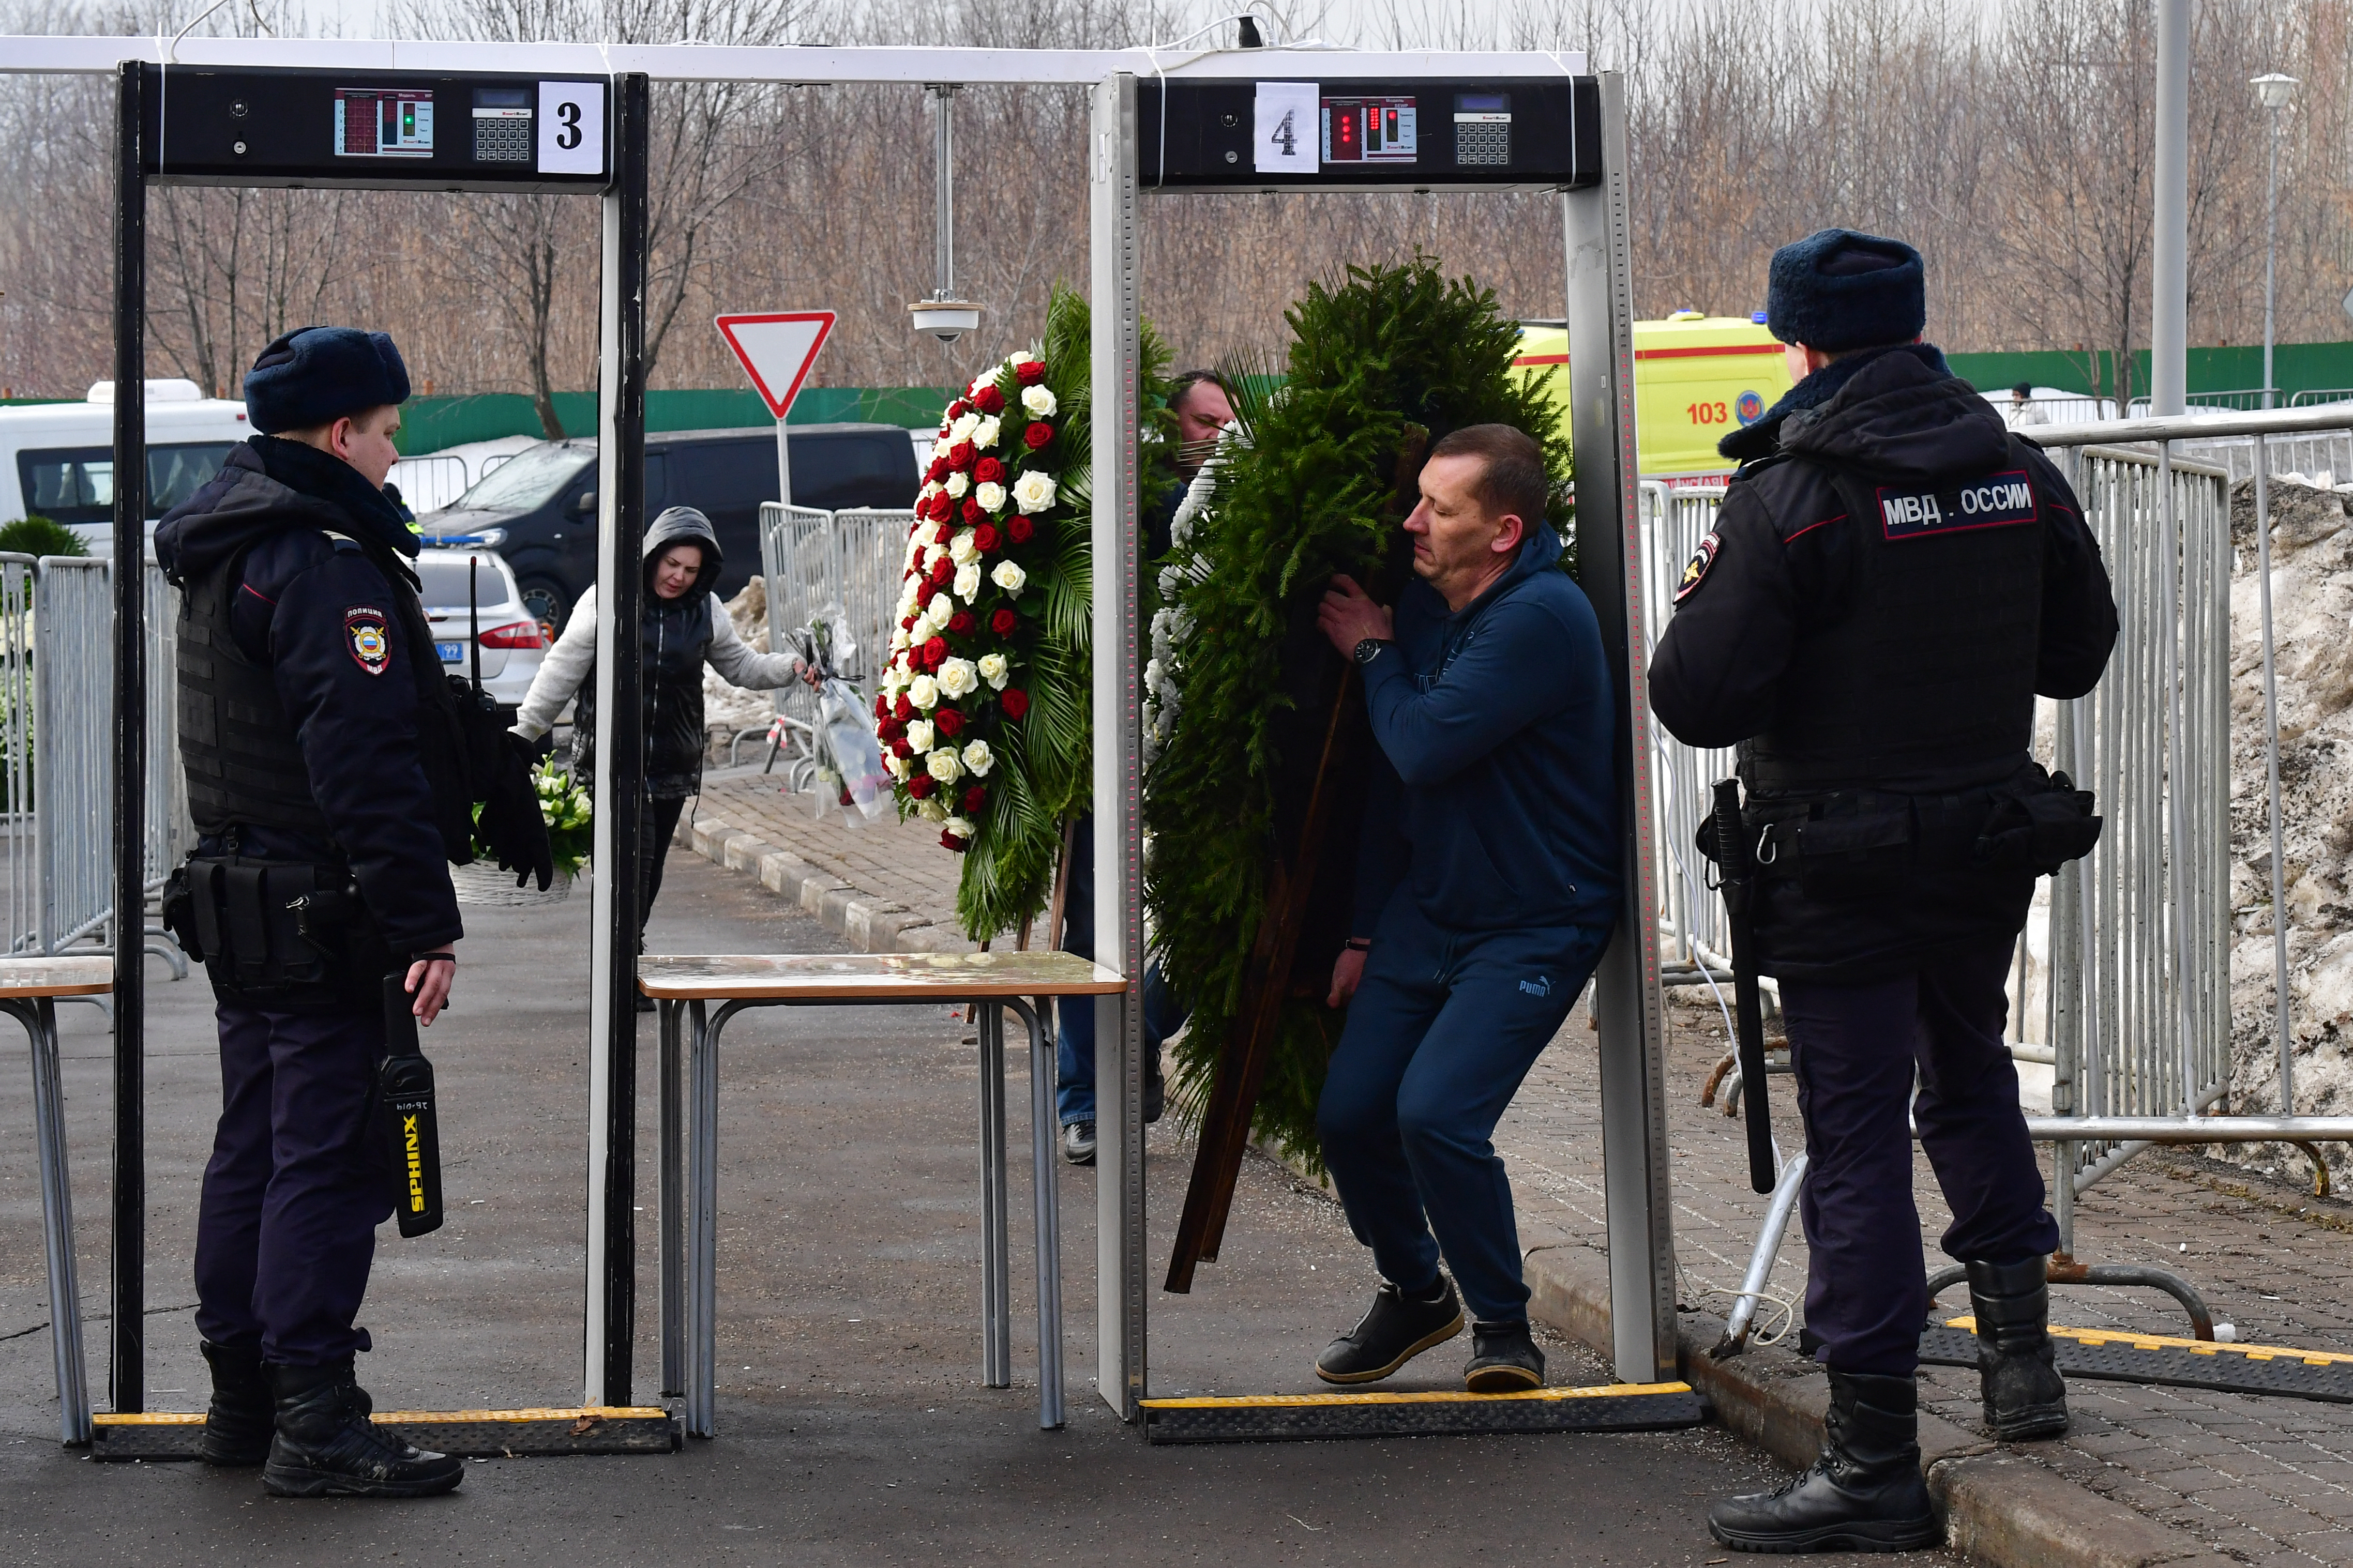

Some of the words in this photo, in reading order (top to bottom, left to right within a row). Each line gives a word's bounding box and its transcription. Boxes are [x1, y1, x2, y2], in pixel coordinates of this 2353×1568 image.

[557, 102, 582, 150] 3
[1271, 109, 1298, 156] 4
[1687, 402, 1727, 424] 103
[1882, 494, 1941, 525] МВД
[1949, 482, 2033, 516] ОССИИ
[348, 607, 383, 618] ПОЛИЦИЯ
[444, 644, 458, 658] 99
[367, 664, 383, 675] МВД
[1519, 980, 1546, 997] PUMA
[403, 1113, 425, 1212] SPHINX
